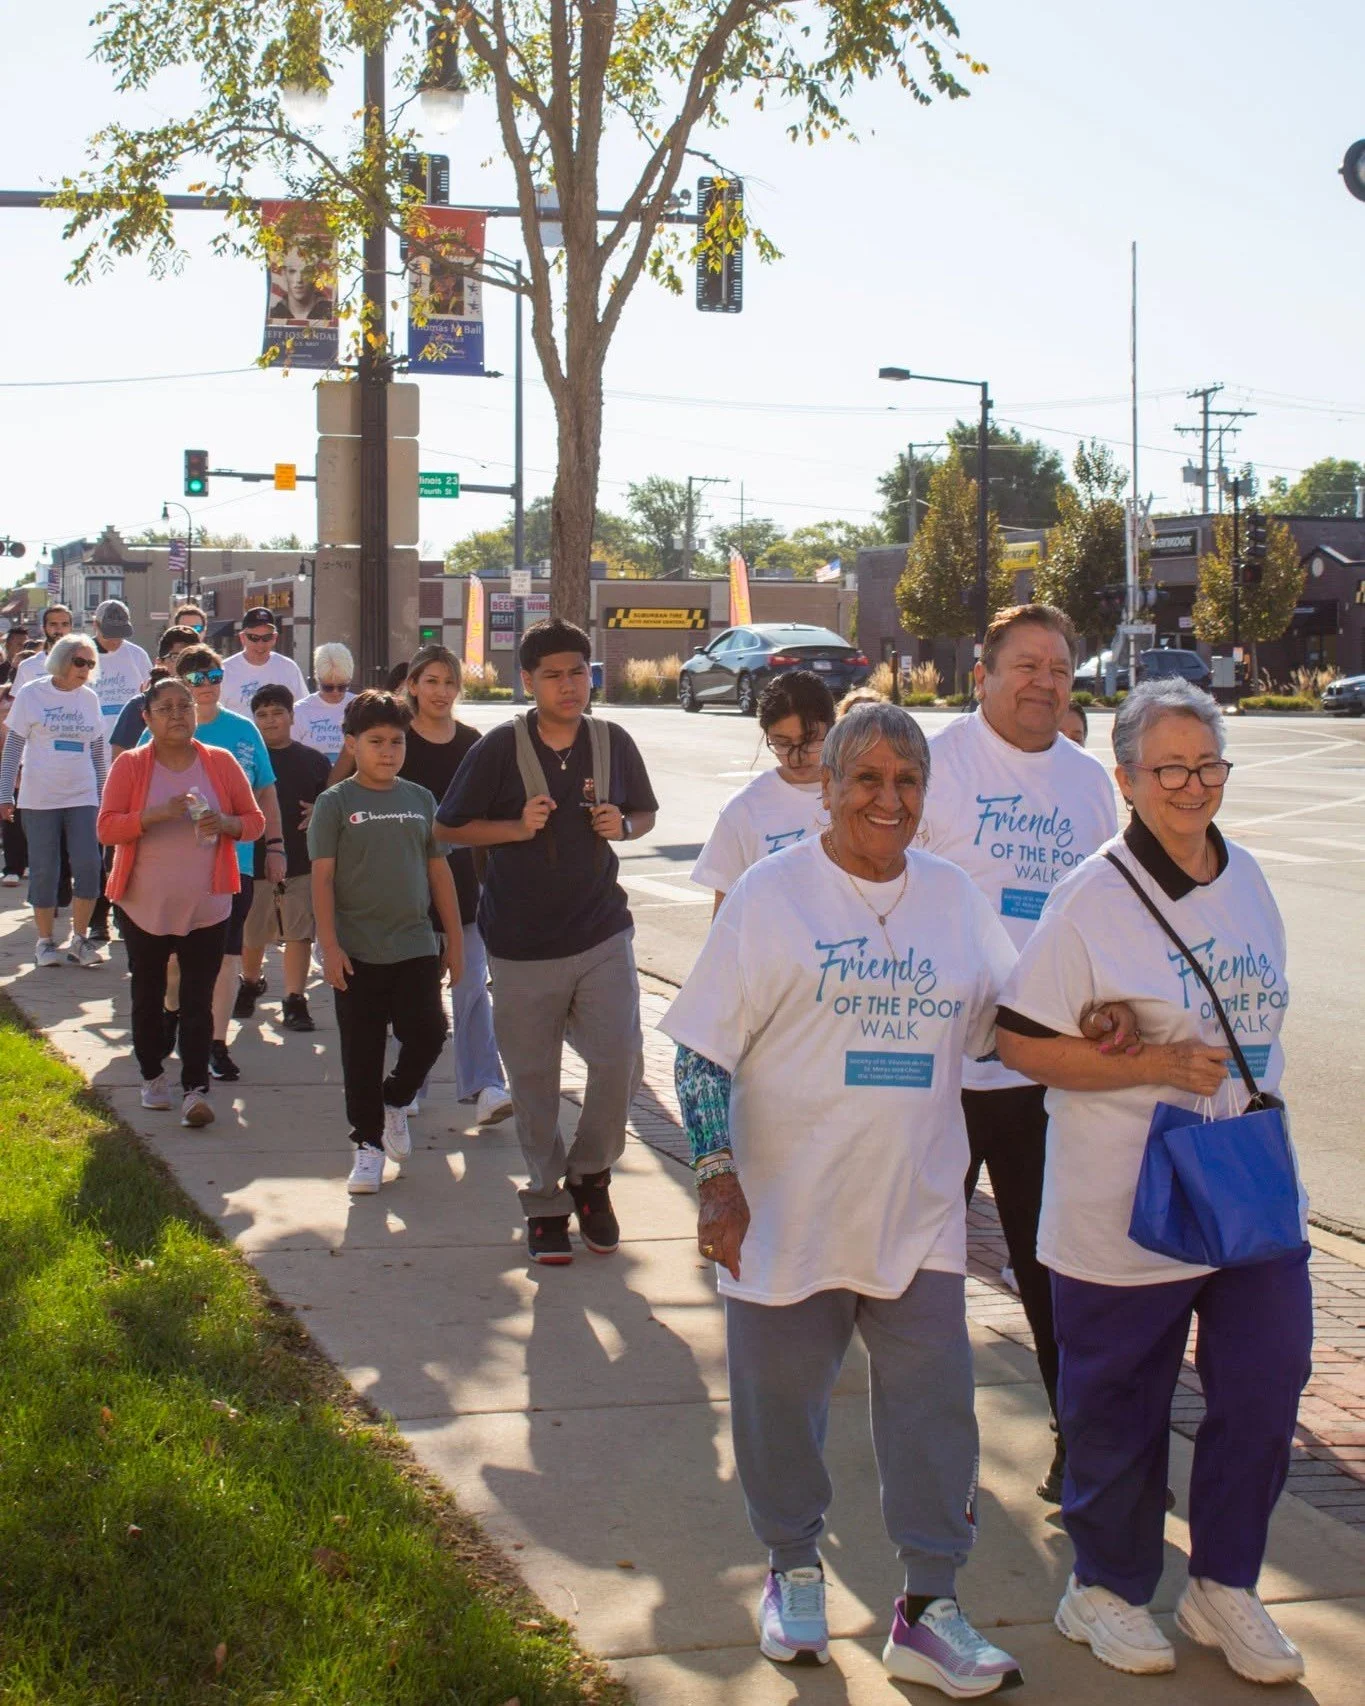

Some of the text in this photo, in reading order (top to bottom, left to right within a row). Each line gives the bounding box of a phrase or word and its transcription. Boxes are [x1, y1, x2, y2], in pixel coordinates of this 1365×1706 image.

[465, 325, 482, 335] Ball
[420, 487, 453, 495] Fourth St
[446, 476, 458, 485] 23
[492, 601, 551, 611] BEER WINE
[973, 794, 1074, 849] Friends
[990, 842, 1086, 867] OF THE POO
[1015, 863, 1060, 884] WALK
[814, 936, 938, 1003] Friends
[833, 995, 863, 1016] OF
[867, 995, 901, 1017] THE
[1221, 993, 1250, 1014] THE
[860, 1018, 919, 1041] WALK
